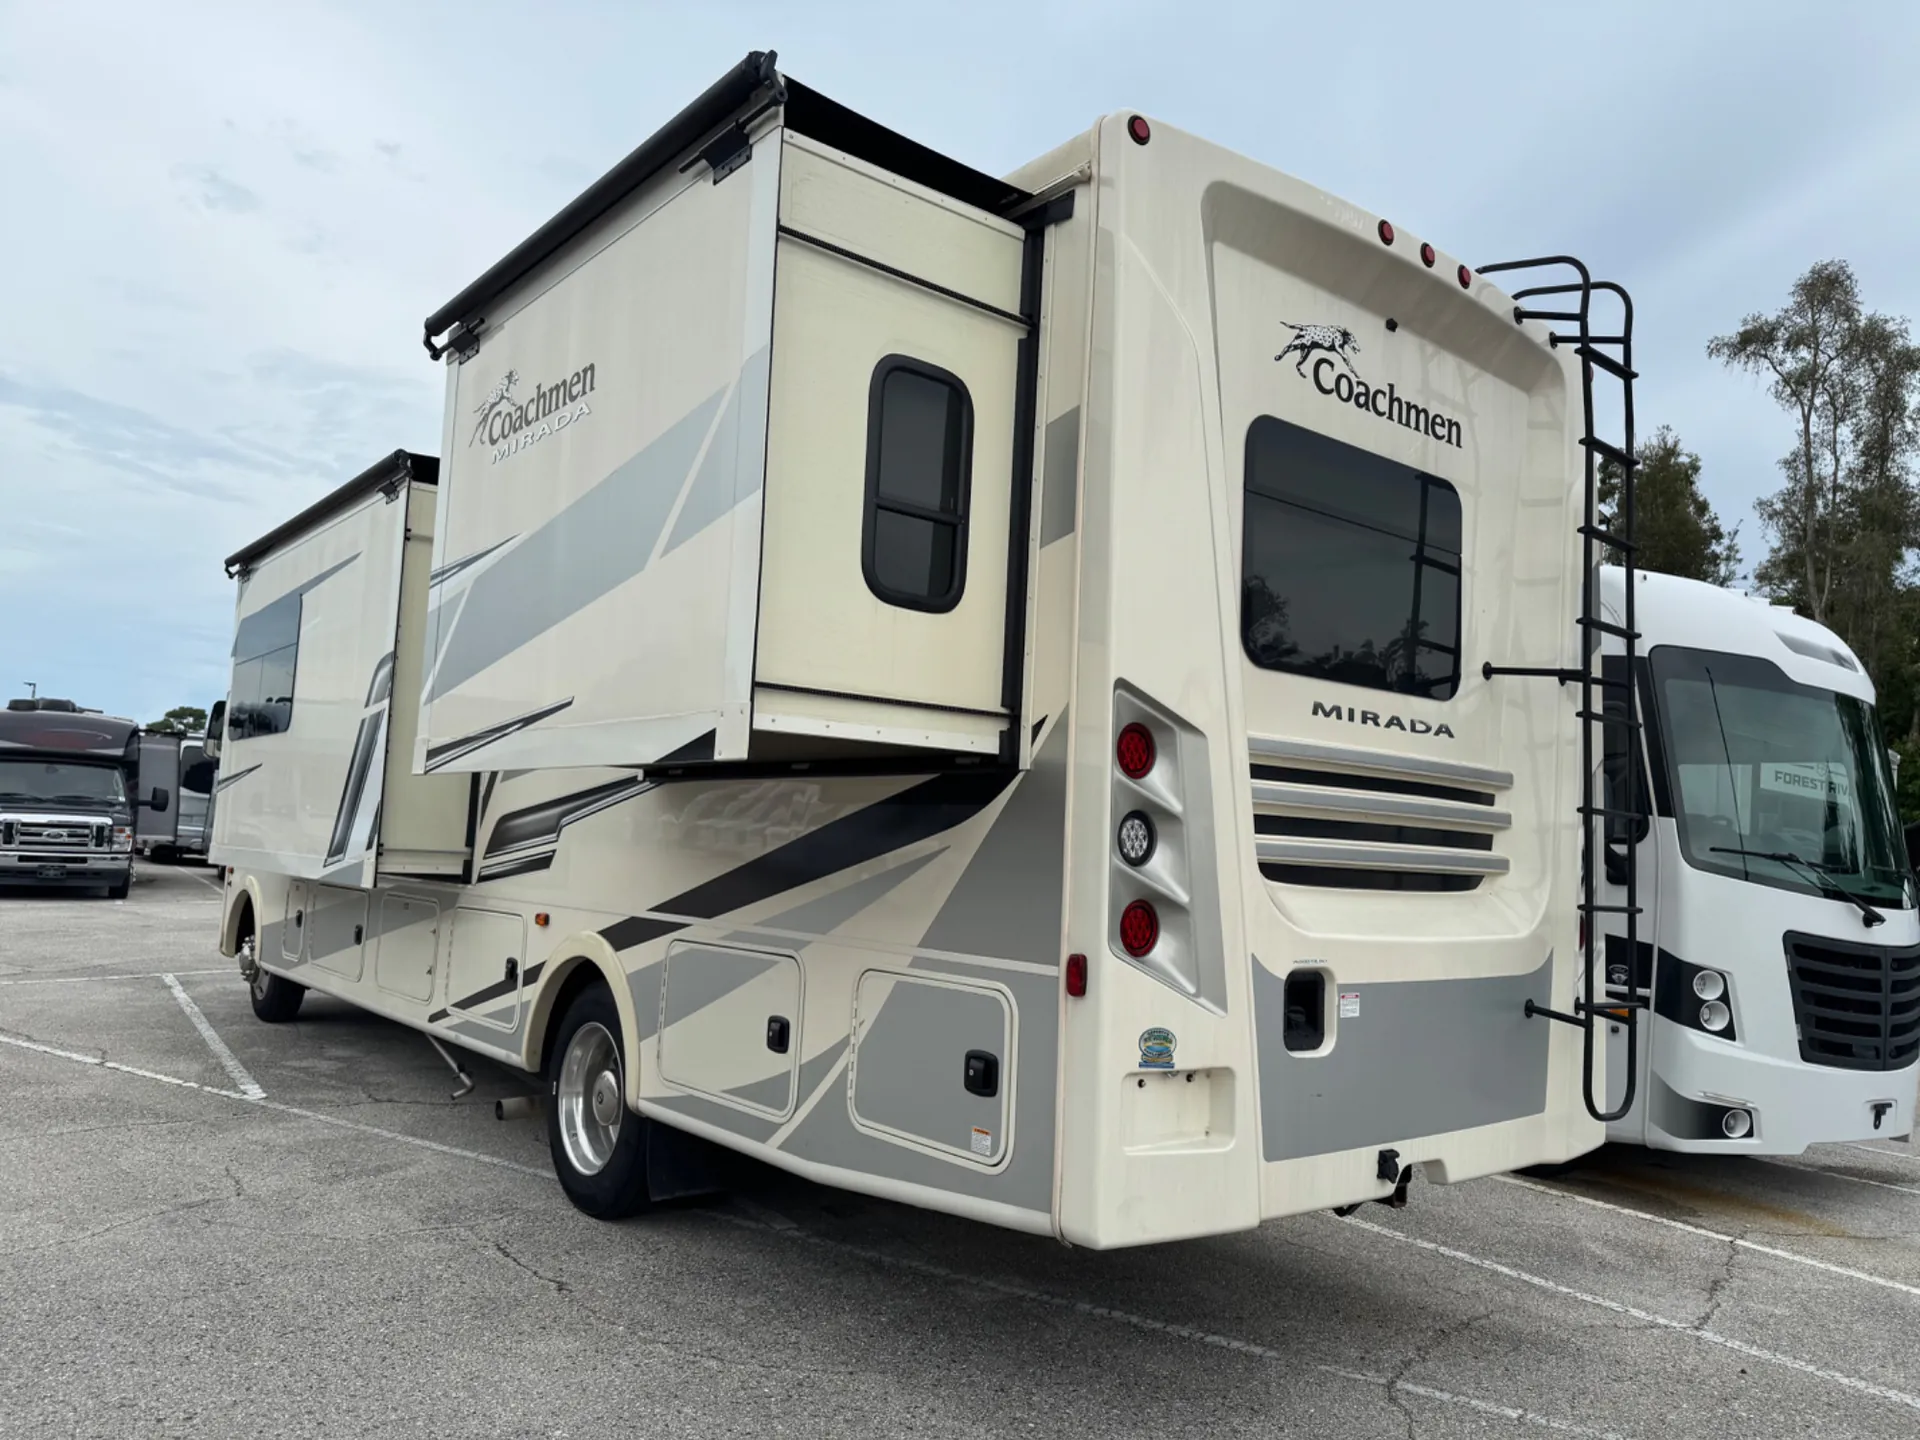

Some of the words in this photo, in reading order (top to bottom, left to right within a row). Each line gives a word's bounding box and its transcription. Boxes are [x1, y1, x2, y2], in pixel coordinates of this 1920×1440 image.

[488, 362, 596, 446] Coachmen
[492, 402, 592, 465] MIRADA
[1312, 357, 1463, 449] Coachmen
[1312, 701, 1455, 739] MIRADA
[1774, 770, 1825, 791] FOREST
[1828, 781, 1848, 796] RIV
